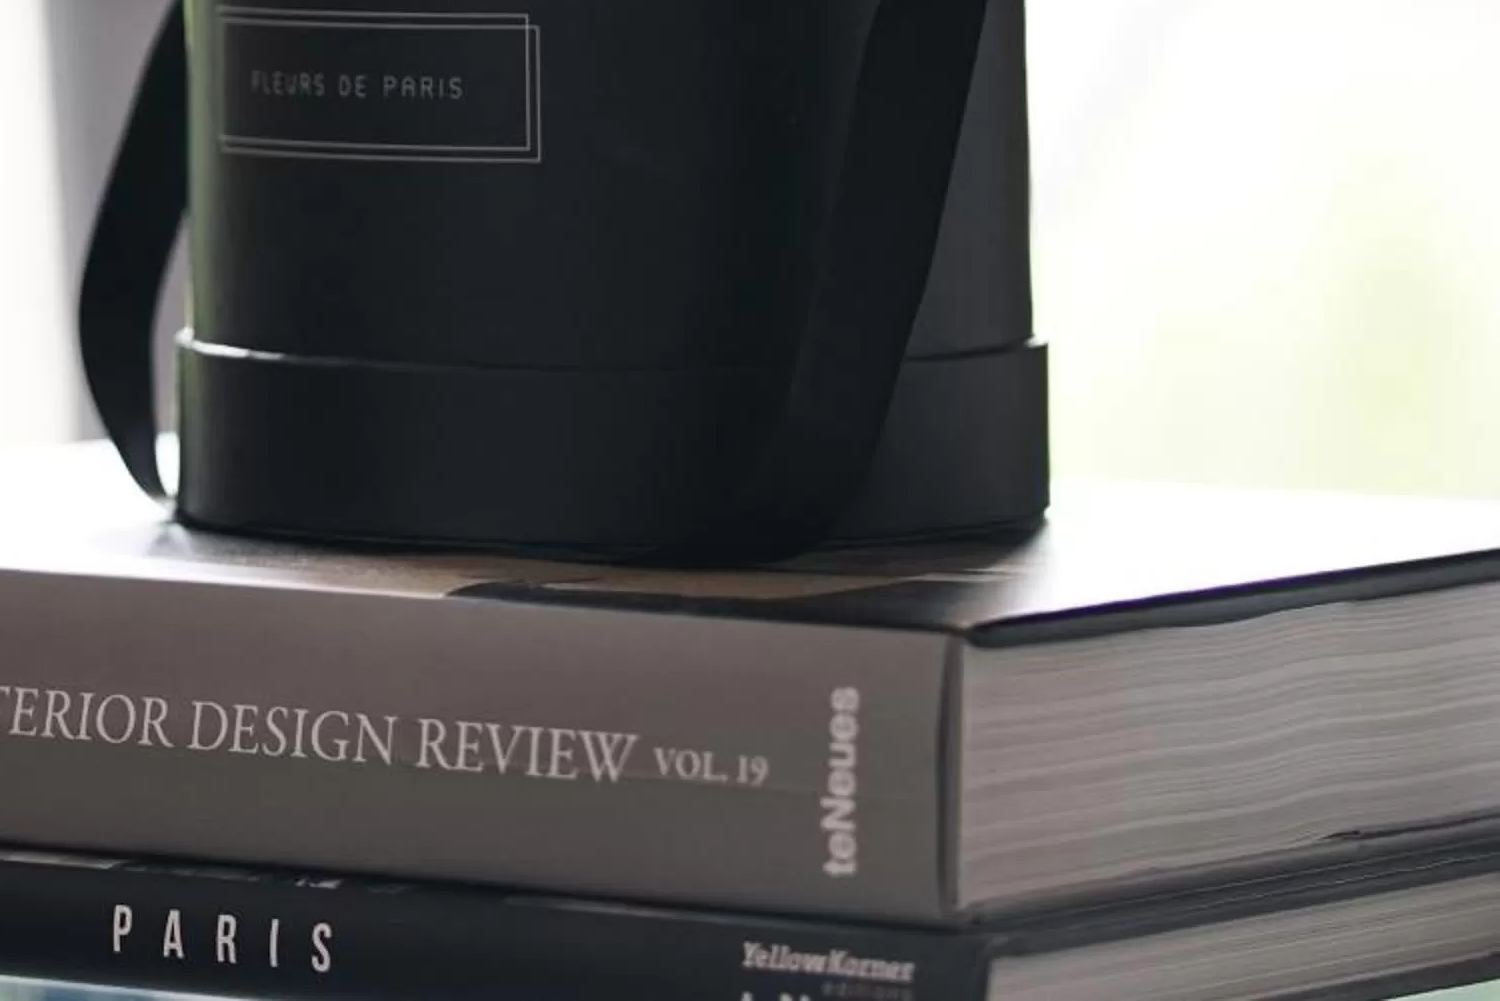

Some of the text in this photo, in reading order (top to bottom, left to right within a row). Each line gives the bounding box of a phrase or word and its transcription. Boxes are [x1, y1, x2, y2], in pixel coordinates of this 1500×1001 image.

[251, 69, 464, 100] FLEURS DE PARIS
[187, 700, 399, 766] DESIGN
[416, 717, 640, 783] REVIEW
[653, 745, 729, 783] VOL.
[736, 754, 771, 787] 19
[820, 686, 860, 877] teNeues
[112, 904, 334, 973] PARIS
